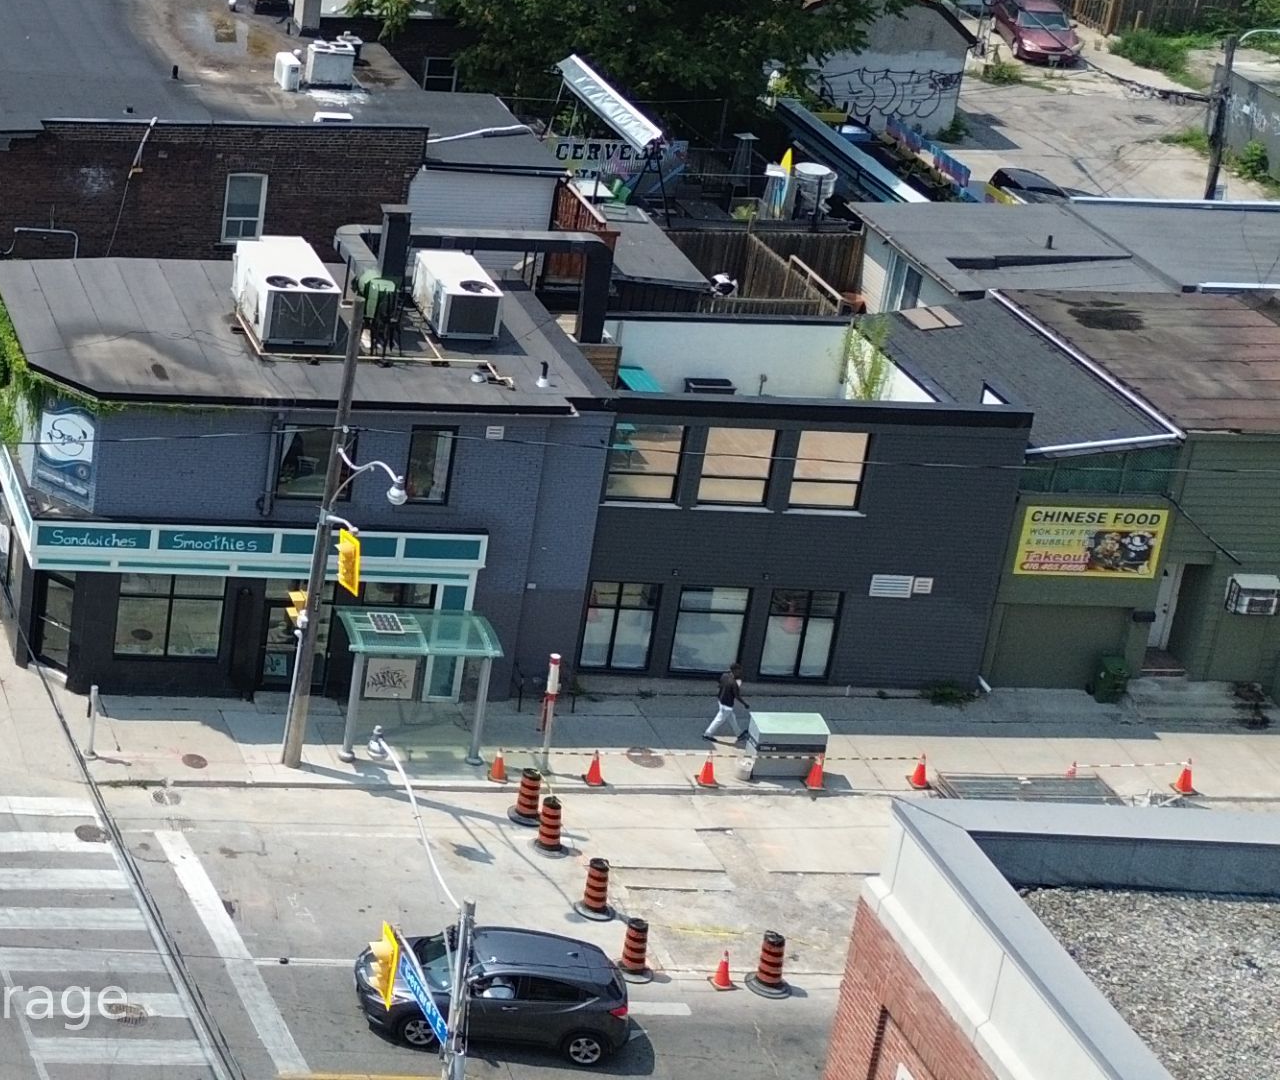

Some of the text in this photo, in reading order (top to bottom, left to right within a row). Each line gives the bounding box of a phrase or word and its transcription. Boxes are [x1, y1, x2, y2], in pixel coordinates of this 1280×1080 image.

[1030, 510, 1161, 526] CHINESE FOOD
[1054, 528, 1076, 536] STIR
[50, 529, 258, 552] Sandwiches Smoothies
[1035, 538, 1074, 546] BUBBLE
[1024, 550, 1089, 562] Takeout
[405, 965, 432, 1015] Gerrard
